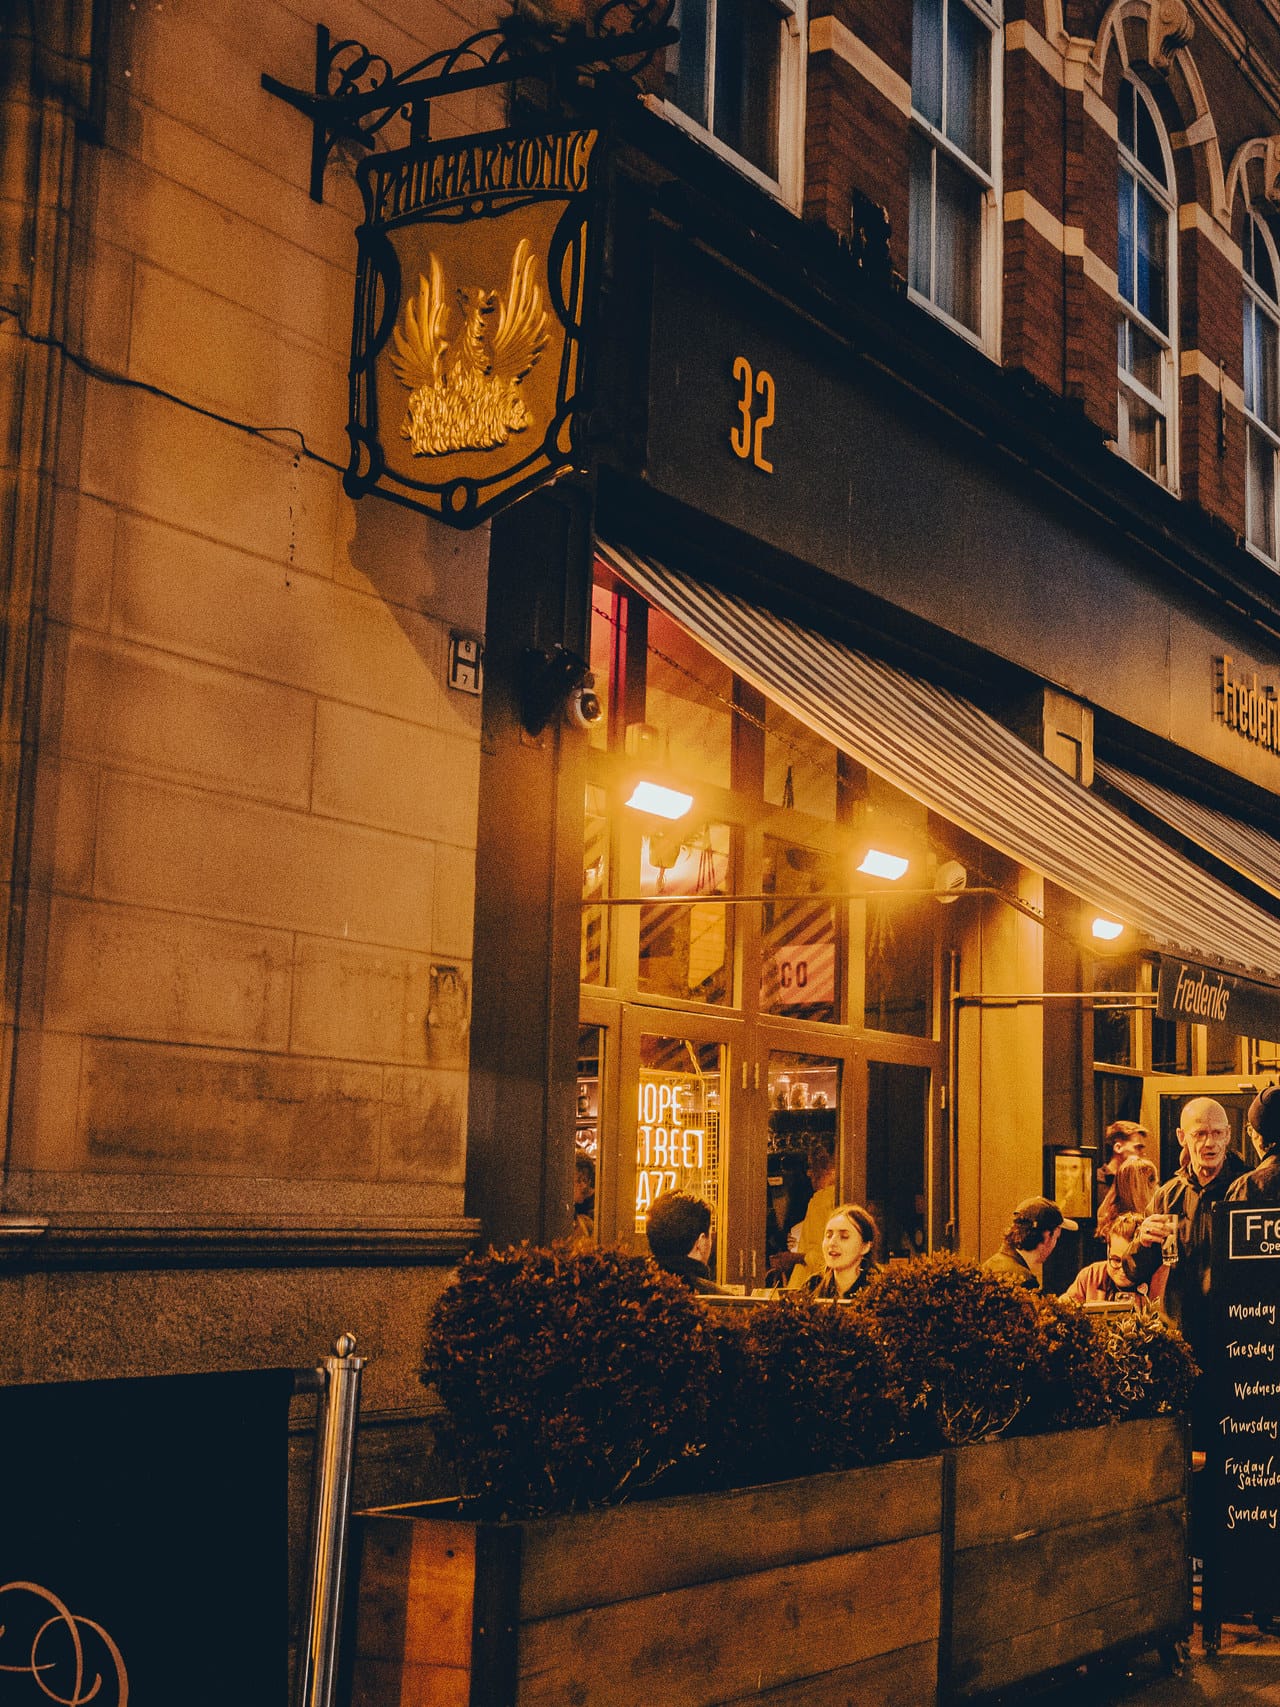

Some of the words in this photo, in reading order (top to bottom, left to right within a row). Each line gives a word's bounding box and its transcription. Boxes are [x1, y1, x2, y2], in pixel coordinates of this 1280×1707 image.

[373, 131, 593, 223] PHILHARMONIC
[730, 356, 776, 473] 32
[637, 1126, 705, 1169] TREET
[1228, 1302, 1276, 1325] Monday
[1225, 1339, 1275, 1361] Tuesday
[1219, 1415, 1278, 1440] Thursday
[1227, 1504, 1278, 1529] Sunday
